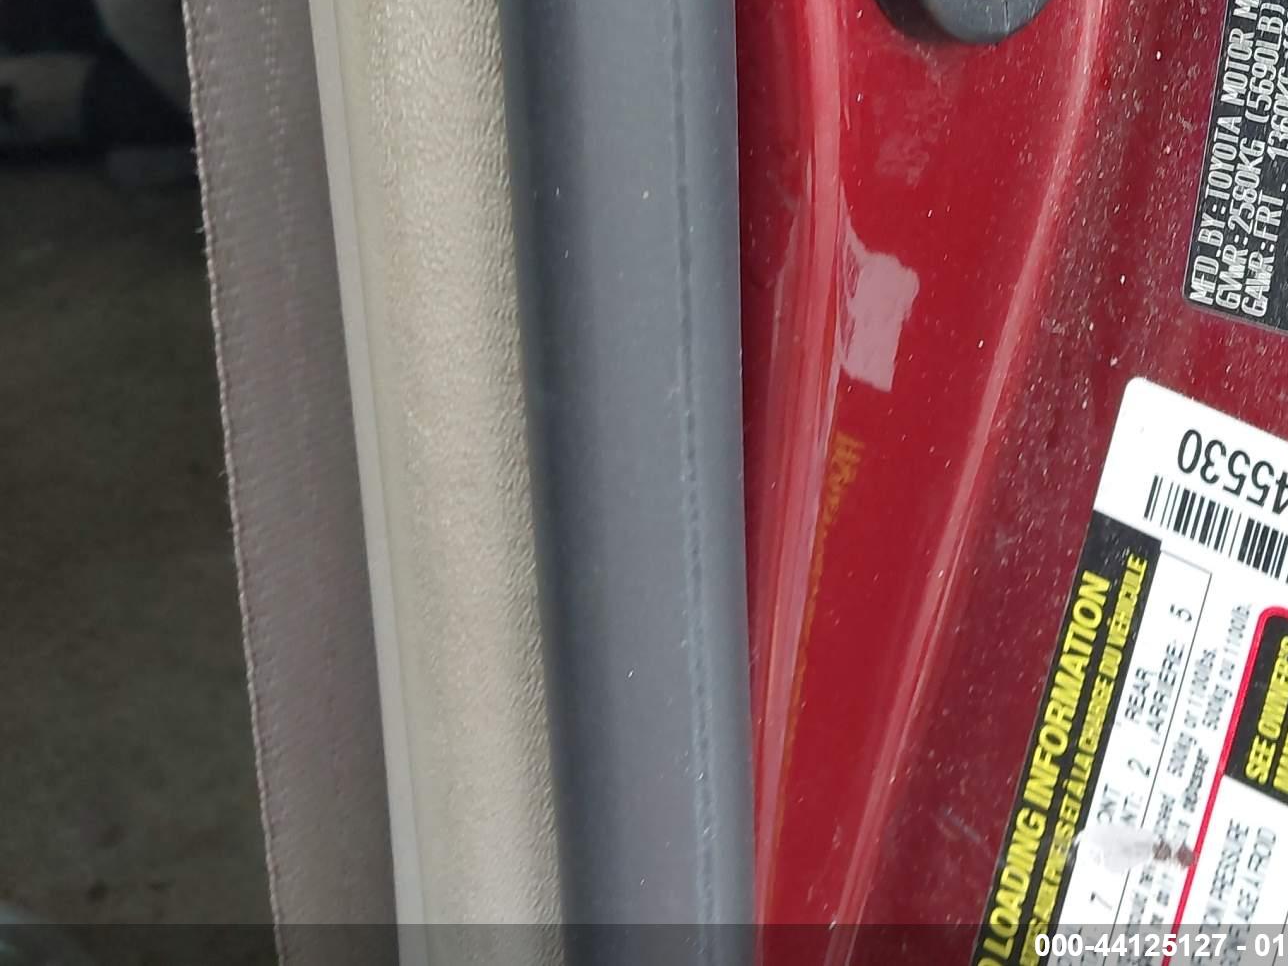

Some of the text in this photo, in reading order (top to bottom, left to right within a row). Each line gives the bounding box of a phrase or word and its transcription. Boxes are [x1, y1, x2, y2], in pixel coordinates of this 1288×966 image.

[1221, 28, 1255, 106] MOTOR
[1245, 3, 1285, 123] (5690LB)
[1169, 603, 1193, 622] 5
[1099, 646, 1122, 679] DU
[983, 570, 1110, 959] LOADING INFORMATION
[1127, 758, 1151, 778] 2
[1245, 735, 1276, 785] SEE
[1089, 892, 1112, 910] 7
